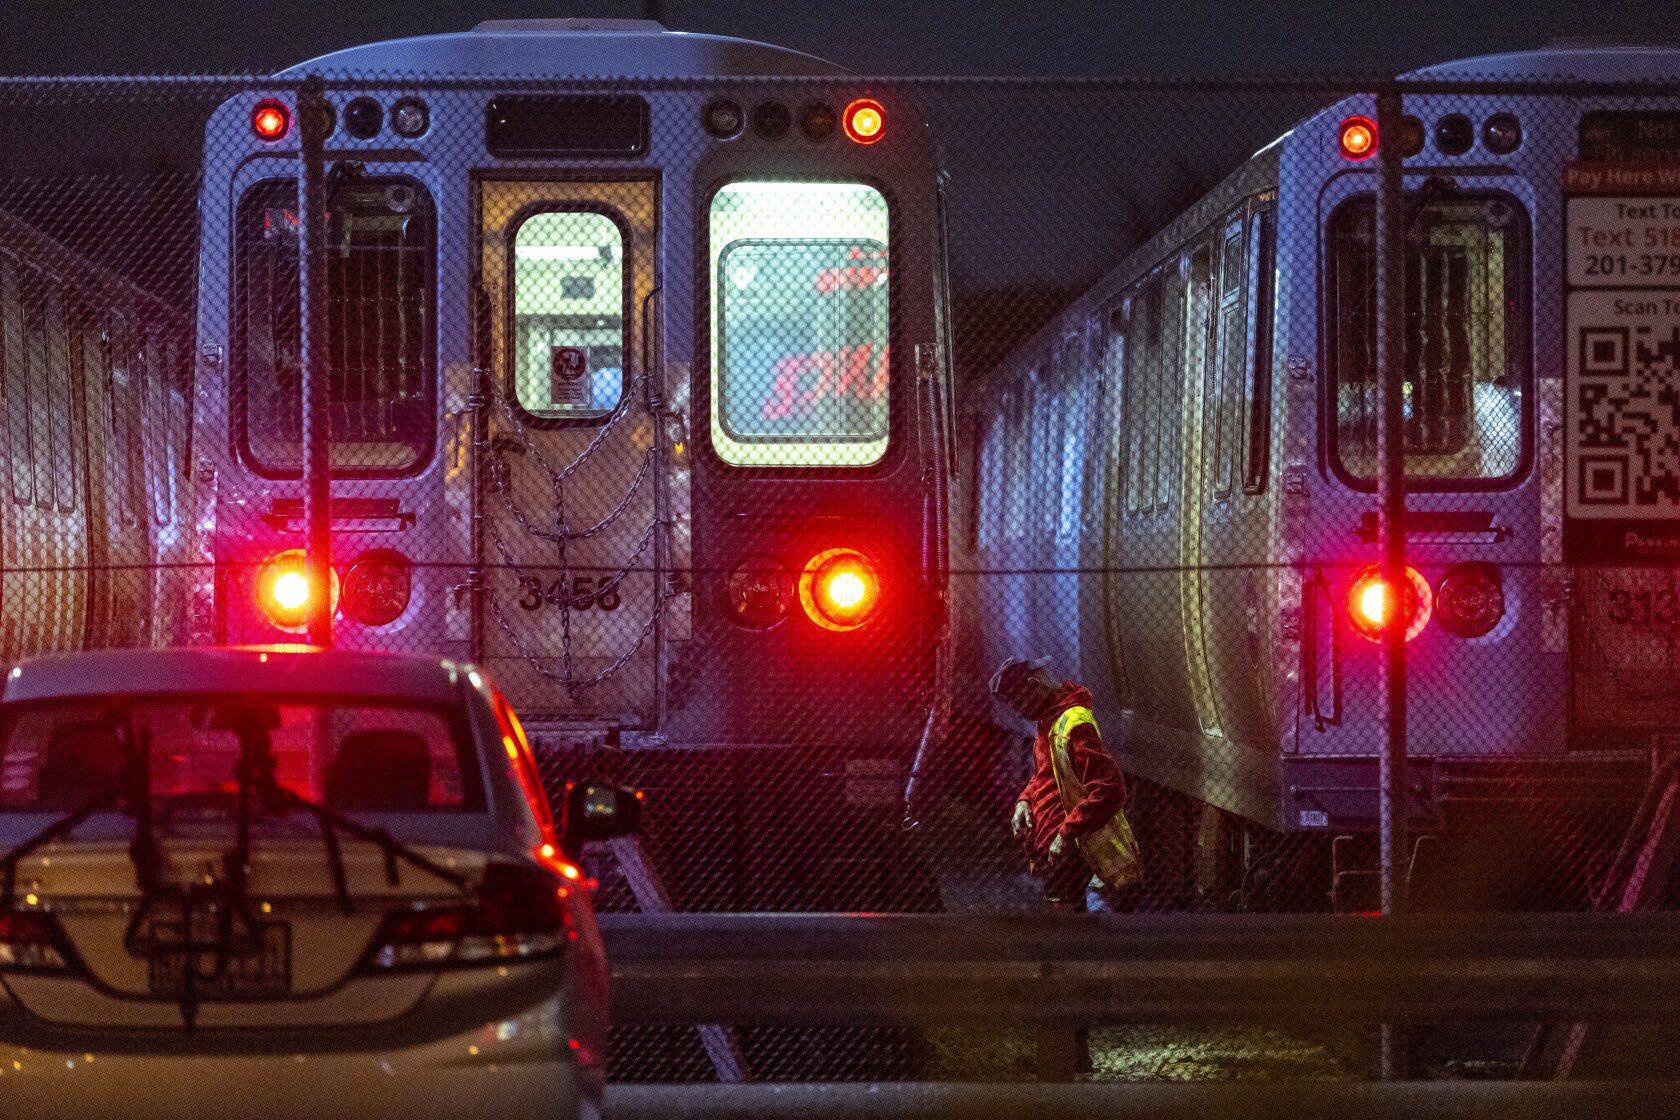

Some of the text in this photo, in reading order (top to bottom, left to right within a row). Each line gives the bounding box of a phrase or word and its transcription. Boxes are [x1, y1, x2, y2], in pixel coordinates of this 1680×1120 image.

[1567, 169, 1601, 189] Pay
[1607, 169, 1653, 185] Here
[1617, 203, 1657, 219] Text
[1578, 226, 1634, 247] Text
[1585, 254, 1680, 276] 201-379
[1614, 299, 1657, 315] Scan
